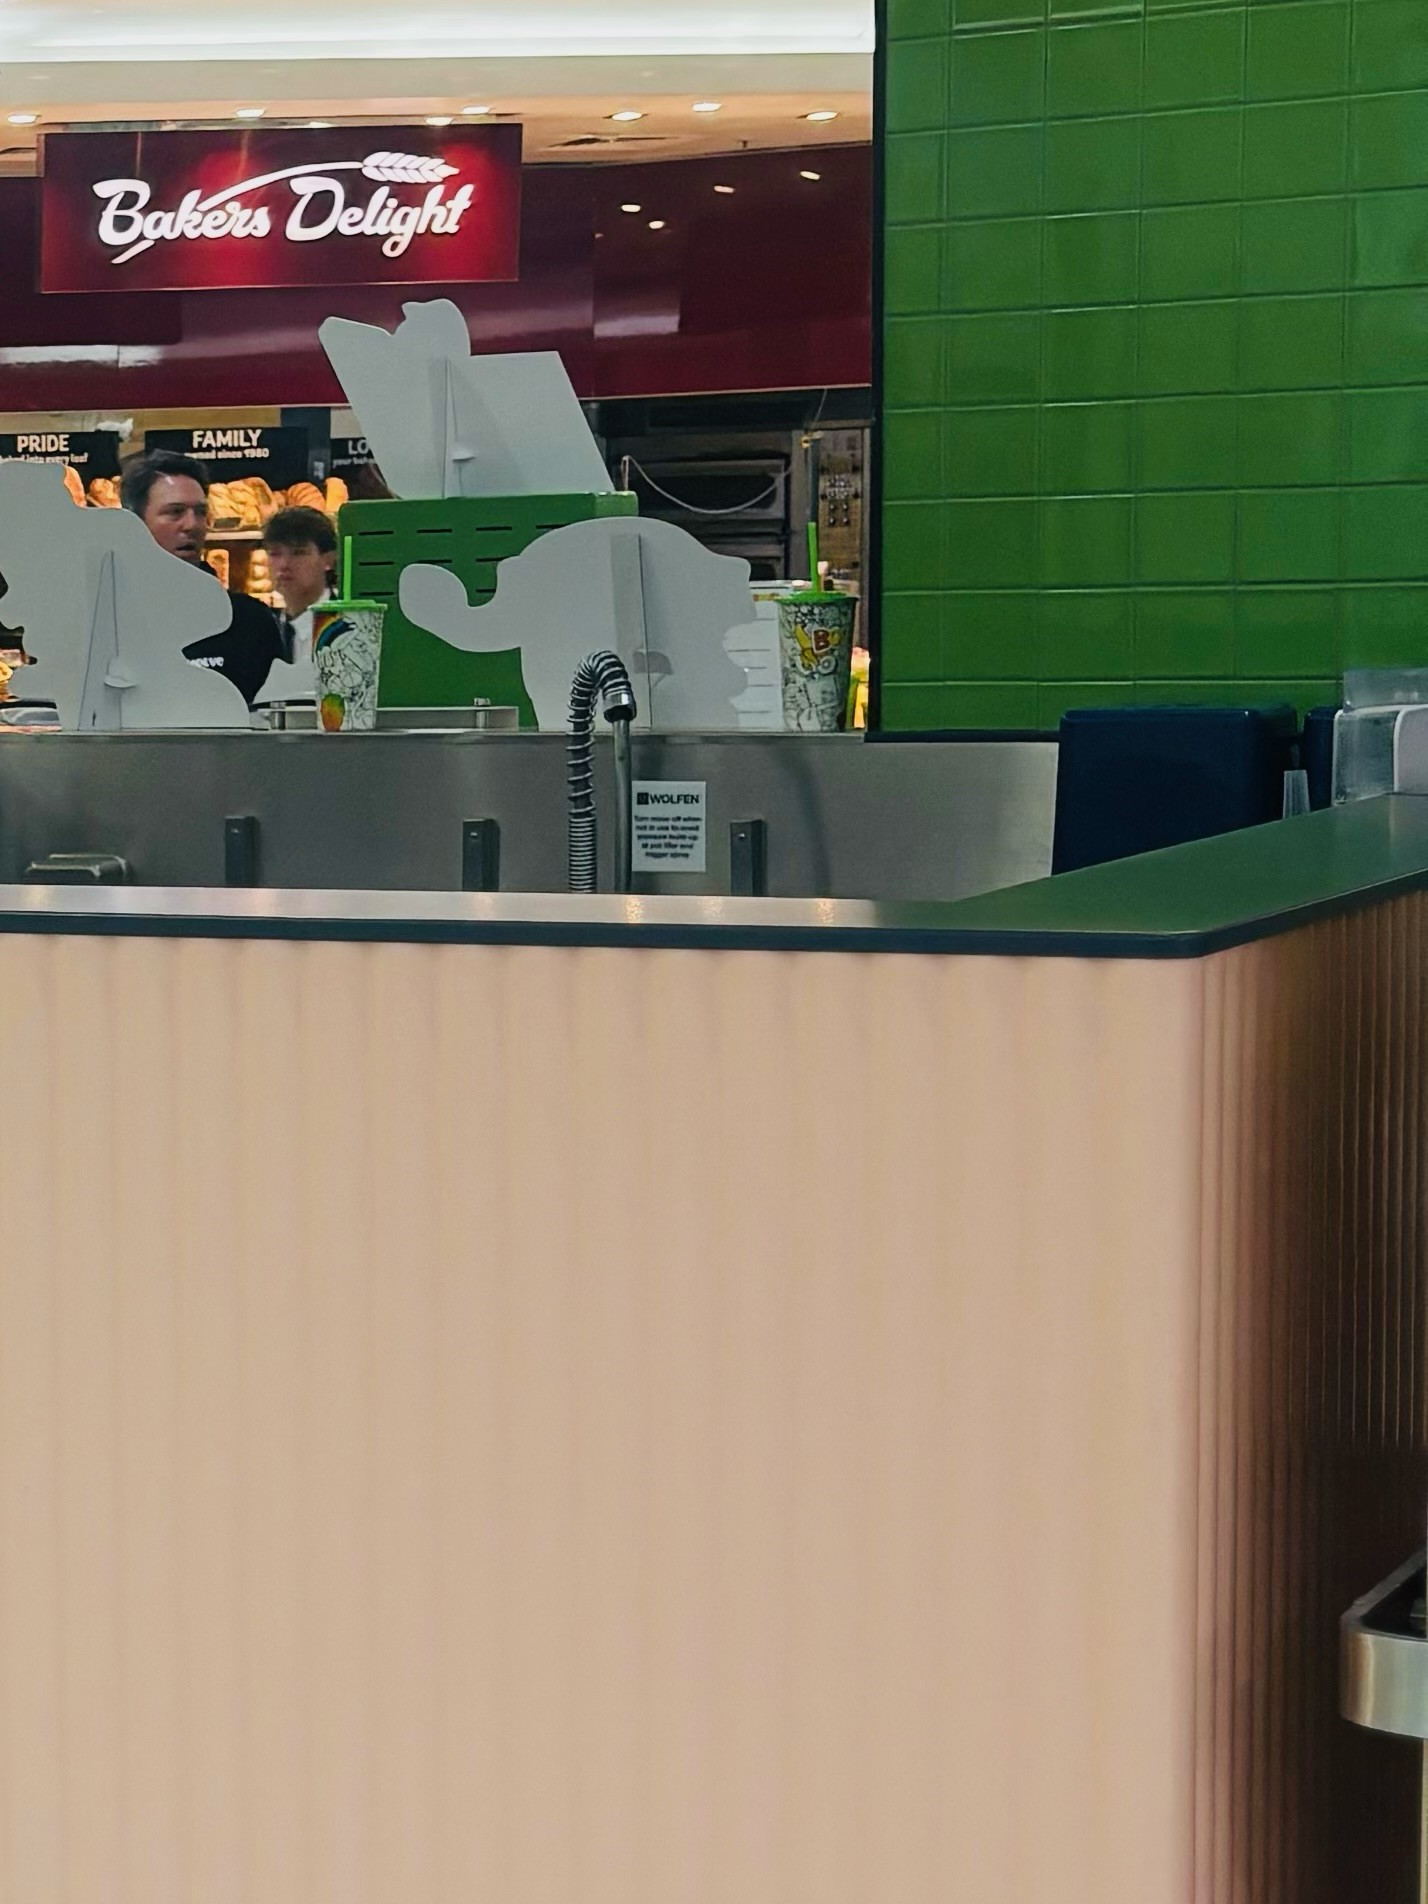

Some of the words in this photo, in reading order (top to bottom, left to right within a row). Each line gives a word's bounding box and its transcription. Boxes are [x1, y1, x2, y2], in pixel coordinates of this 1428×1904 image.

[92, 178, 271, 264] Bakers
[284, 176, 475, 258] Delight
[17, 434, 70, 453] PRIDE
[192, 429, 263, 449] FAMILY
[217, 449, 243, 459] since
[245, 447, 270, 459] 1980
[650, 794, 700, 804] WOLFEN
